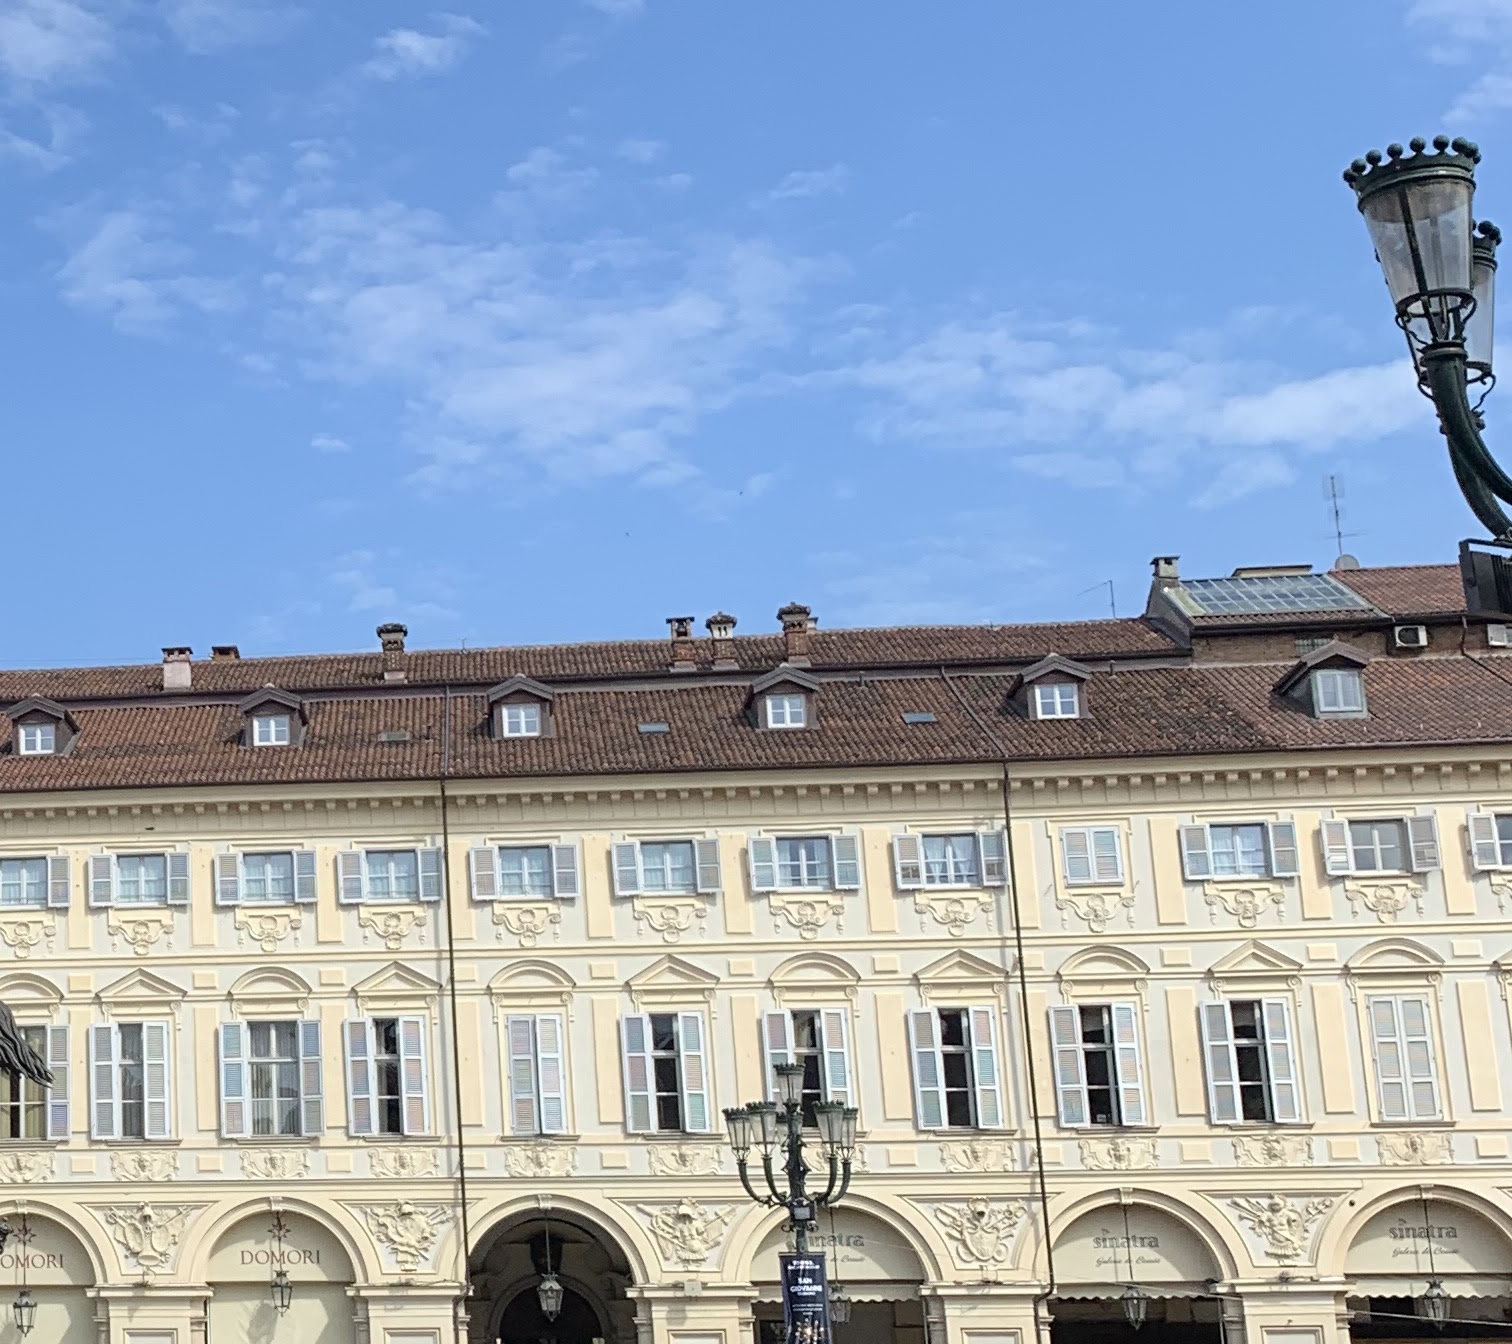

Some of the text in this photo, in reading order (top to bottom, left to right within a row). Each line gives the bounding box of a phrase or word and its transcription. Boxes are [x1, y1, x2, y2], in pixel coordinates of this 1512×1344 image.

[1389, 1220, 1458, 1239] sinatra
[807, 1233, 865, 1248] inatra
[1093, 1230, 1159, 1249] sinatra
[240, 1249, 320, 1265] DOMORI
